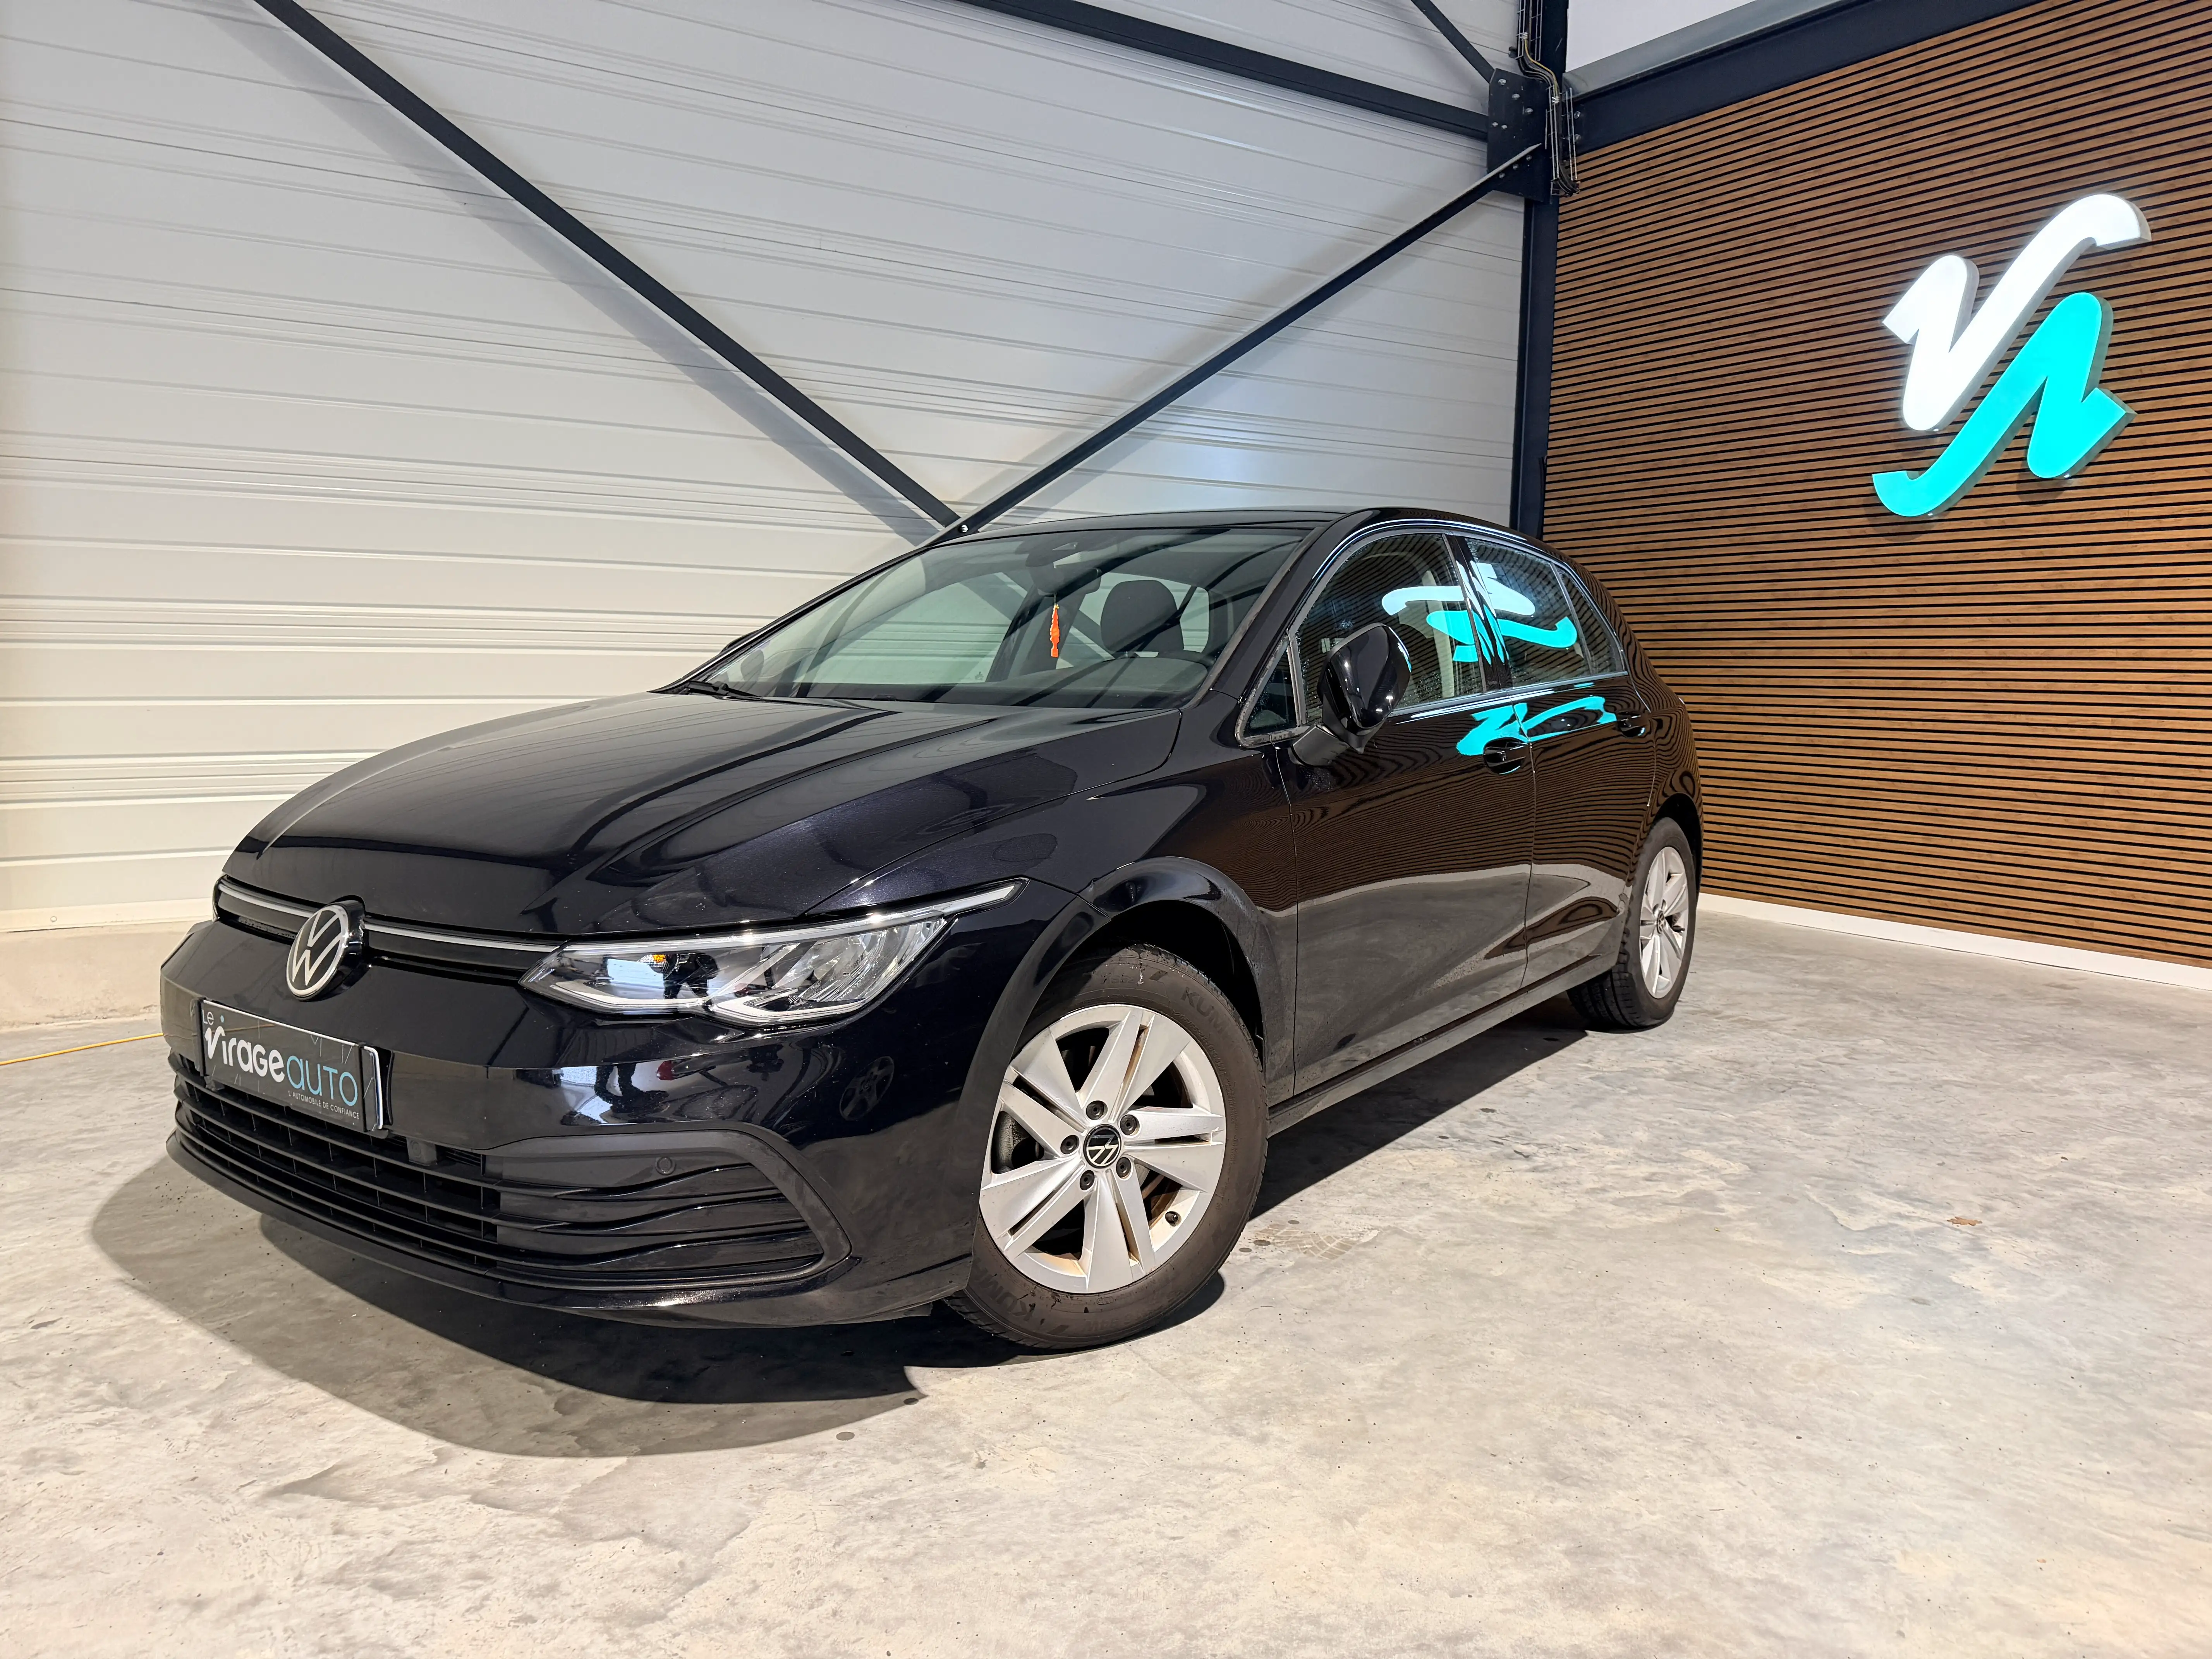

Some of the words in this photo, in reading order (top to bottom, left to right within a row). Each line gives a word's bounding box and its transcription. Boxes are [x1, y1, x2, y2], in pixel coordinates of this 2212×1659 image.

[202, 1009, 214, 1025] Le
[322, 1101, 329, 1110] DE
[330, 1104, 360, 1120] CONFIANCE
